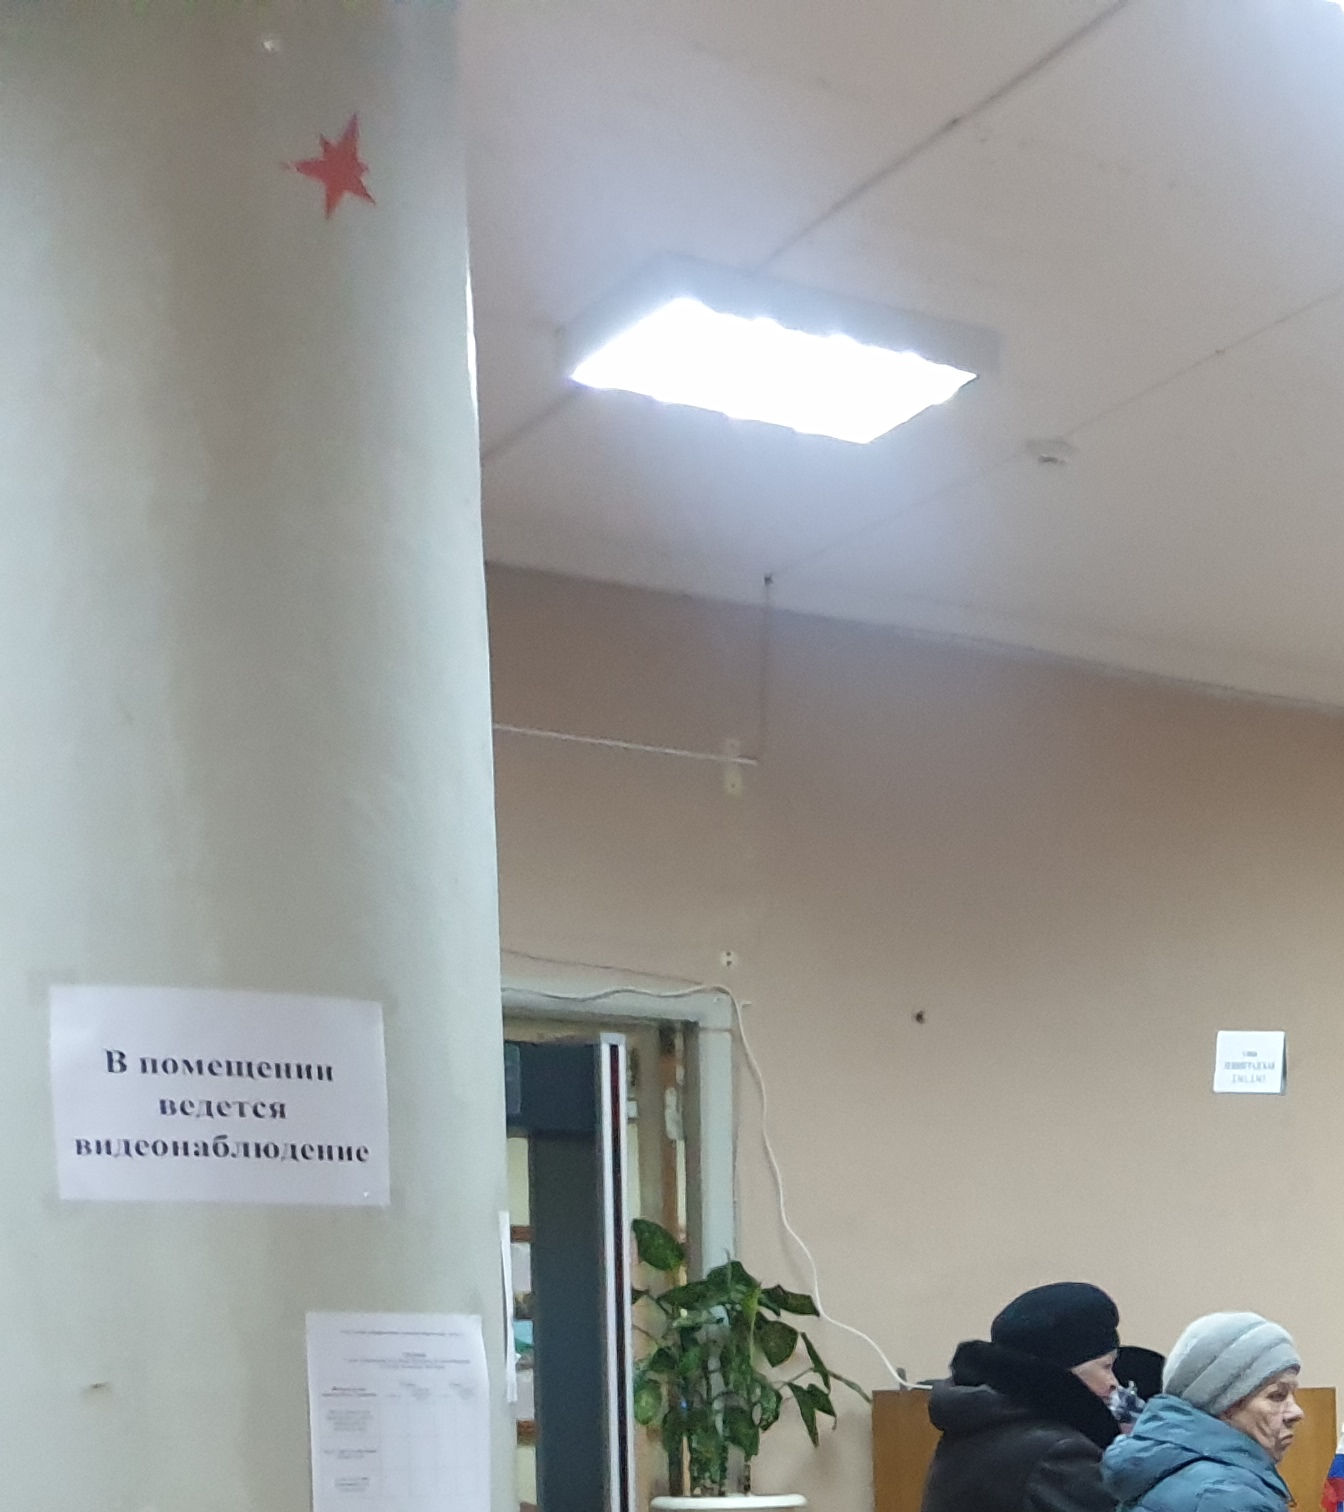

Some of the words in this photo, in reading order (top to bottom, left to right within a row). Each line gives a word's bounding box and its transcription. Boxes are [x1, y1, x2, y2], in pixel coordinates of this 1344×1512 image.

[103, 1048, 128, 1075] В
[139, 1056, 335, 1083] помещении
[158, 1098, 288, 1120] ведется
[75, 1134, 371, 1163] видеонаблюдение
